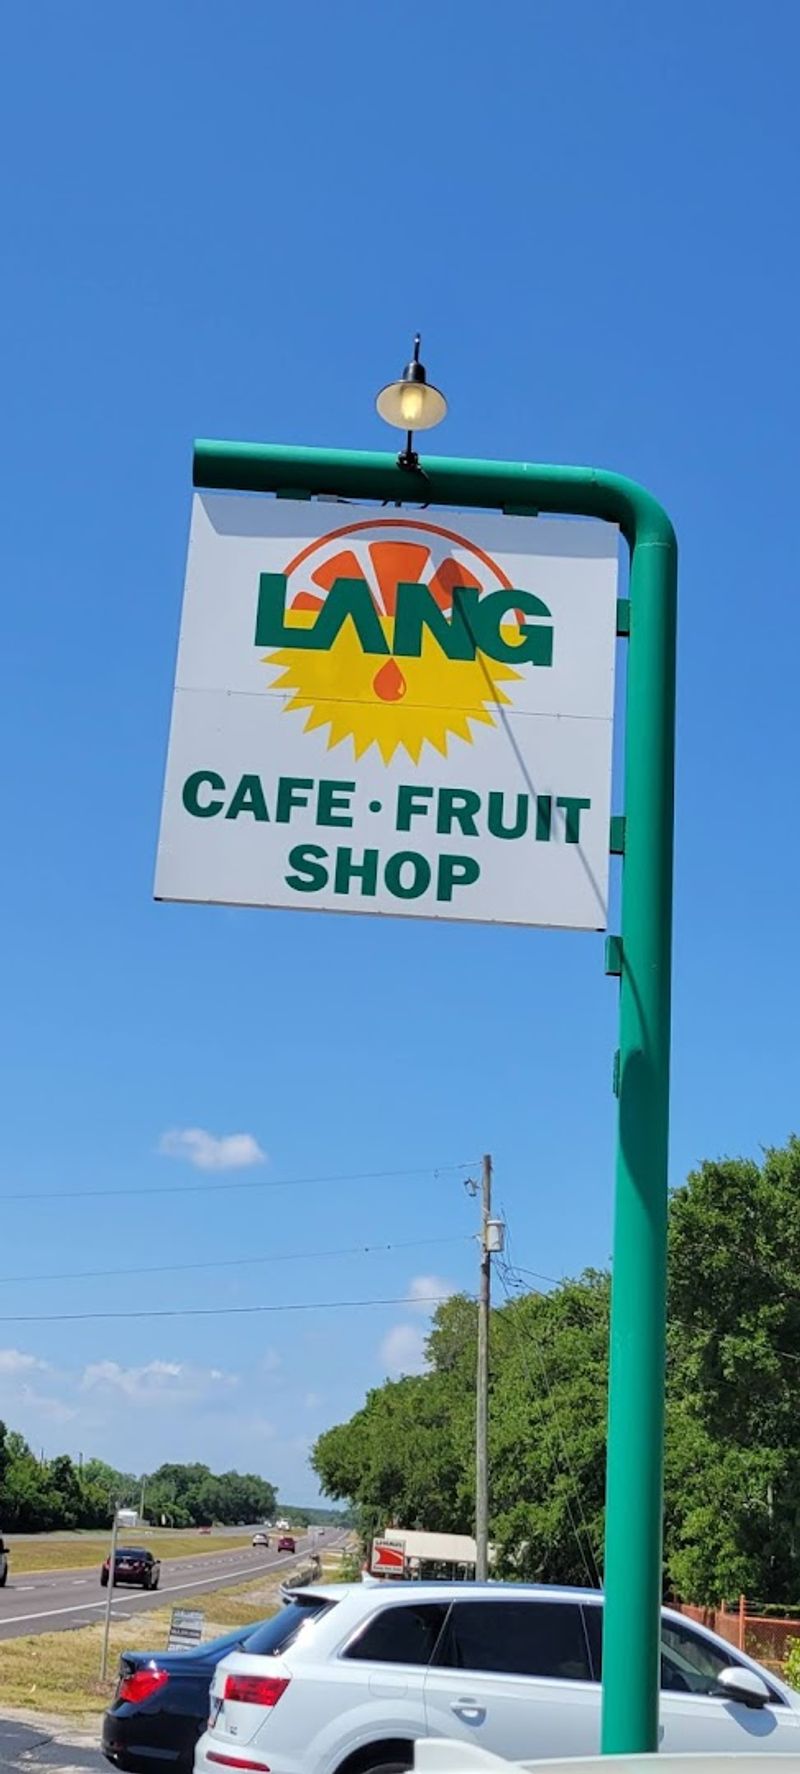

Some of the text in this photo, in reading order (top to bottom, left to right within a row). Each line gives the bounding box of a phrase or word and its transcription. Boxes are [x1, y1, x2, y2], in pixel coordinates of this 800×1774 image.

[254, 572, 554, 667] LANG
[182, 770, 591, 845] CAFE FRUIT
[284, 844, 481, 902] SHOP
